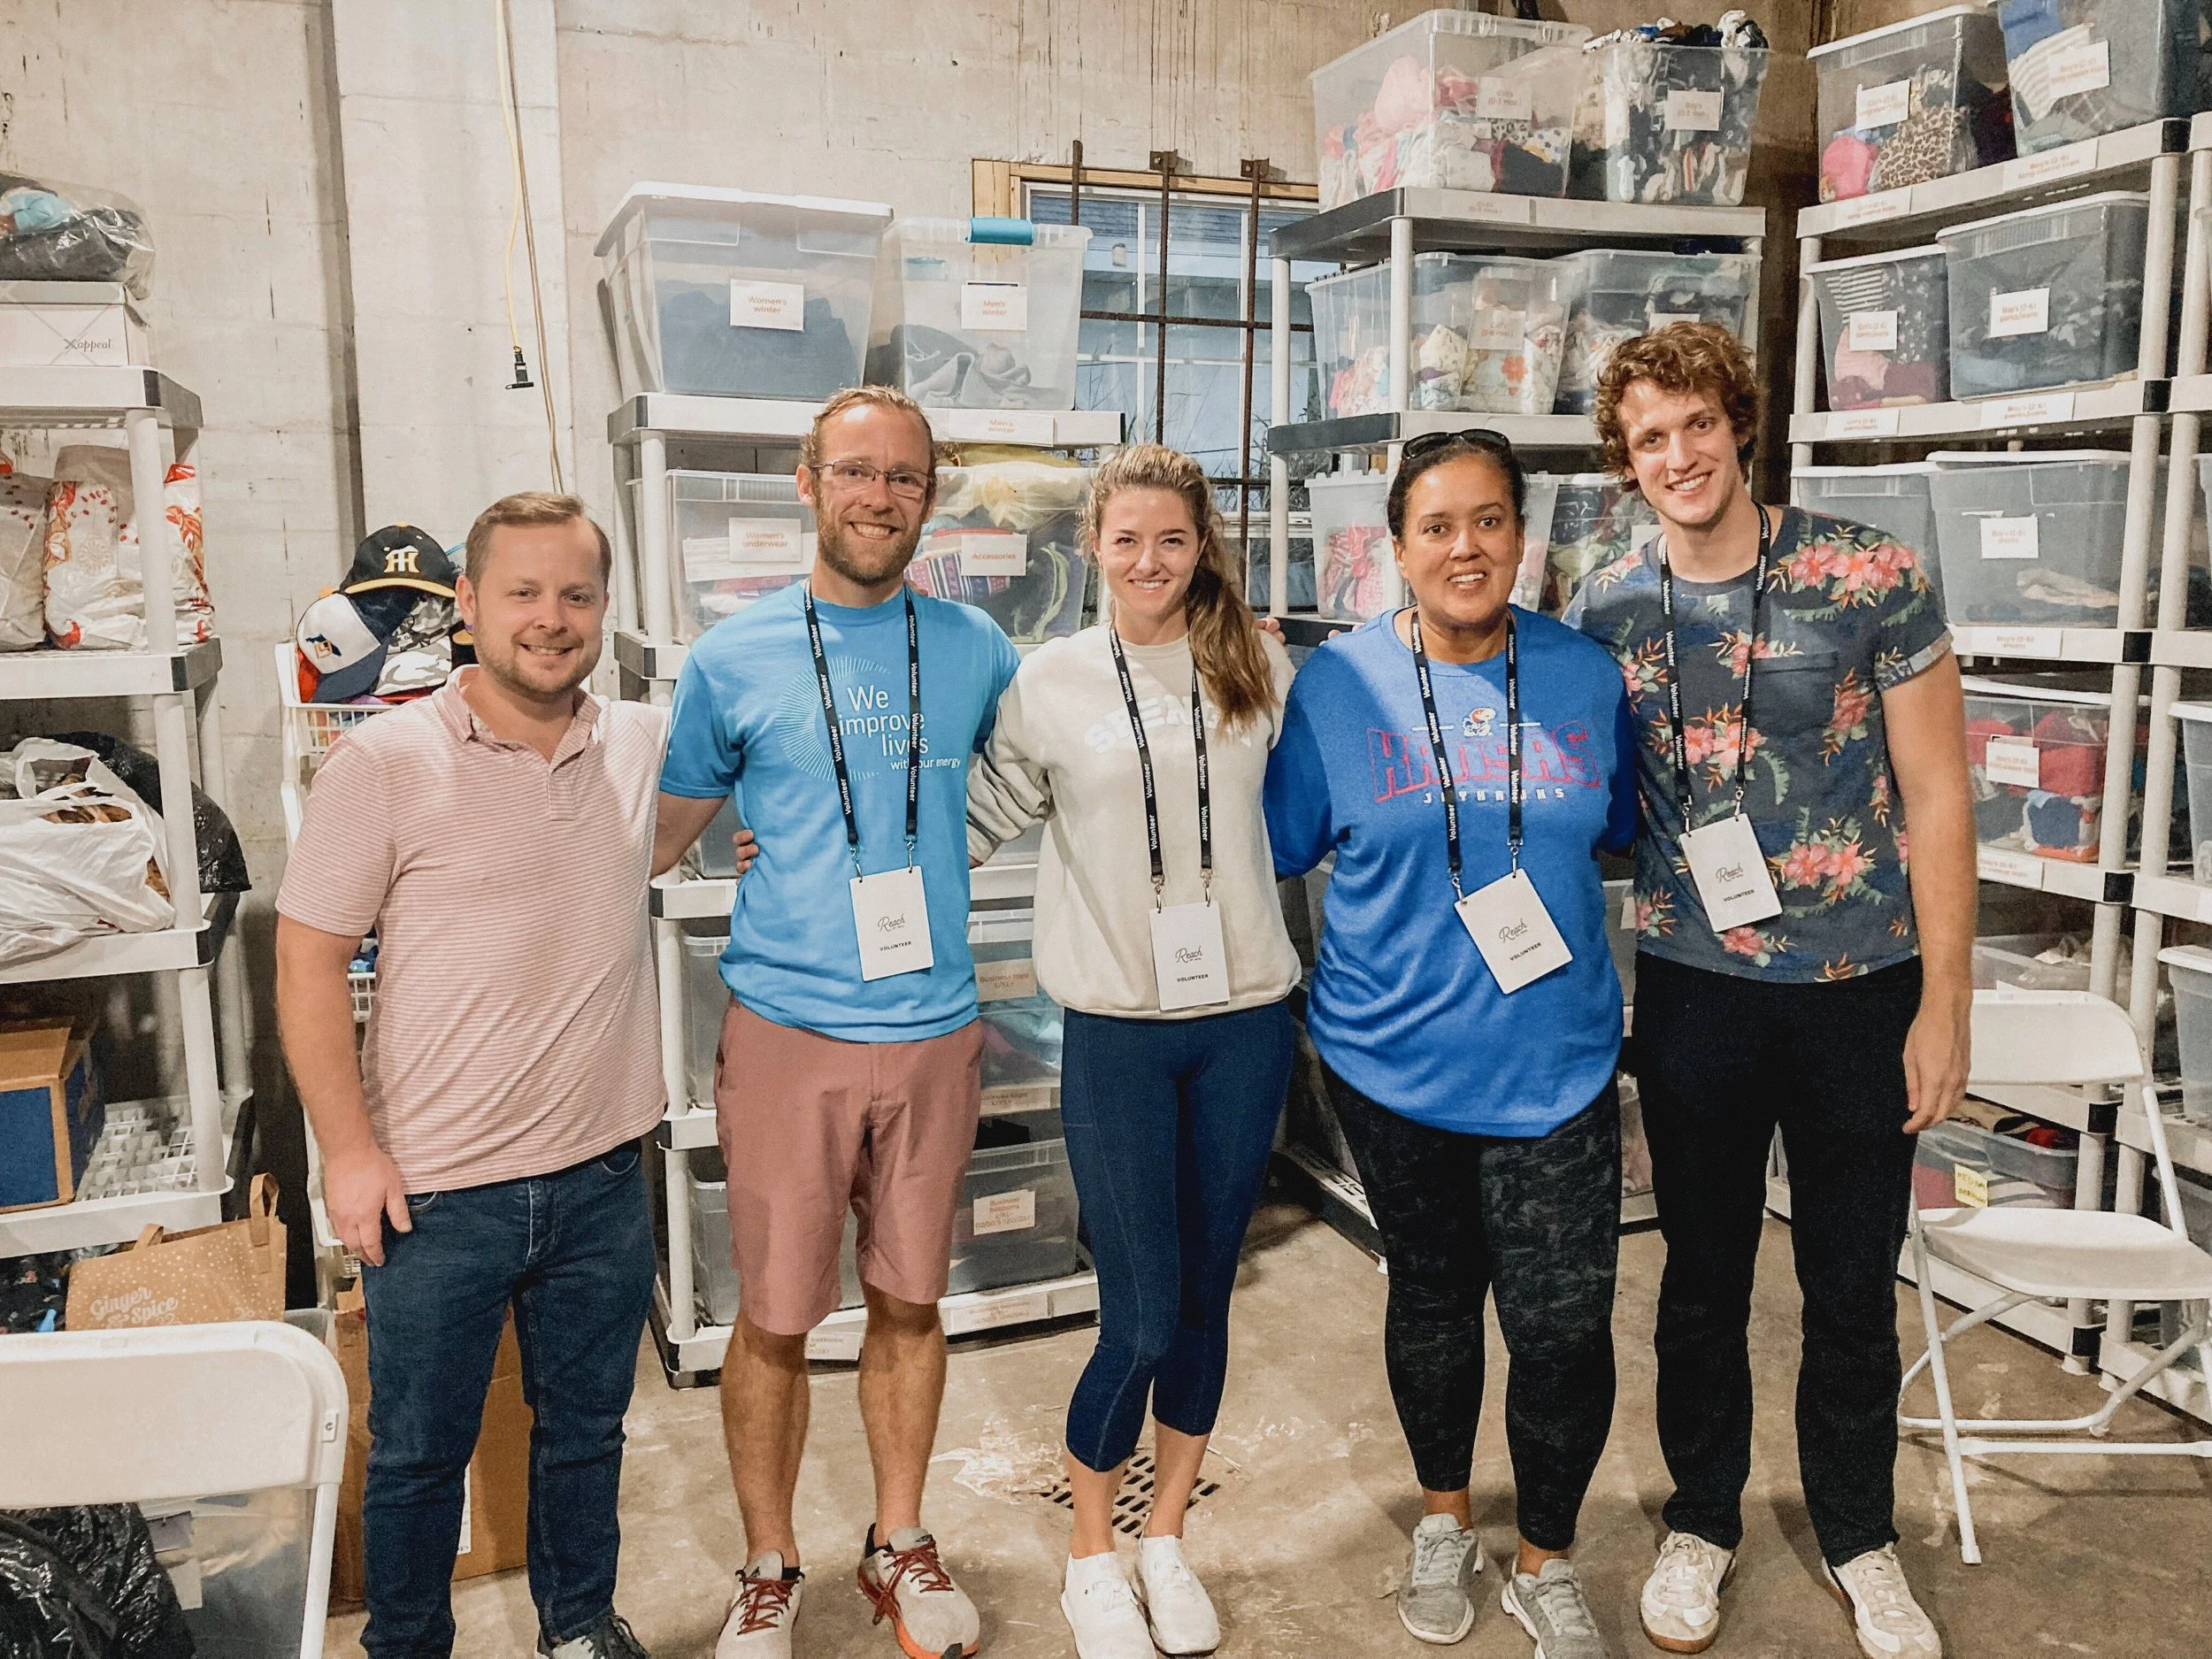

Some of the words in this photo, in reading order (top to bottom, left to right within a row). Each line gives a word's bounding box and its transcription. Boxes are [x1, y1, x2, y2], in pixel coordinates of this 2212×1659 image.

[749, 296, 787, 305] Women's
[746, 531, 785, 540] Women's
[1755, 554, 1767, 592] Volunteer
[1662, 580, 1671, 616] Volunteer
[810, 624, 822, 658] Volunteer
[1665, 630, 1675, 667] Volunteer
[819, 673, 832, 709] Volunteer
[847, 685, 889, 711] We
[1120, 671, 1133, 703] Volunteer
[1419, 666, 1431, 699] Volunteer
[1671, 682, 1679, 718] Volunteer
[830, 725, 842, 762] Volunteer
[1133, 716, 1145, 748] Volunteer
[1428, 711, 1440, 744] Volunteer
[881, 733, 929, 757] livs
[1675, 733, 1684, 771] Volunteer
[891, 760, 910, 771] wit
[935, 757, 961, 769] energy
[1439, 757, 1452, 788] Volunteer
[1144, 763, 1153, 798] Volunteer
[1510, 769, 1519, 804] Volunteer
[841, 779, 851, 815] Volunteer
[1149, 815, 1158, 849] Volunteer
[1448, 803, 1457, 841] Volunteer
[1716, 861, 1744, 883] Reach
[1722, 888, 1755, 902] VOLUNTEER
[877, 912, 906, 933] Reach
[1499, 918, 1527, 944] Reach
[879, 941, 912, 951] VOLUNTEER
[1175, 945, 1203, 963] Reach
[1509, 941, 1542, 961] VOLUNTEER
[1177, 973, 1209, 982] VOLUNTEER
[90, 1286, 151, 1322] Ginger
[131, 1296, 178, 1325] Spice
